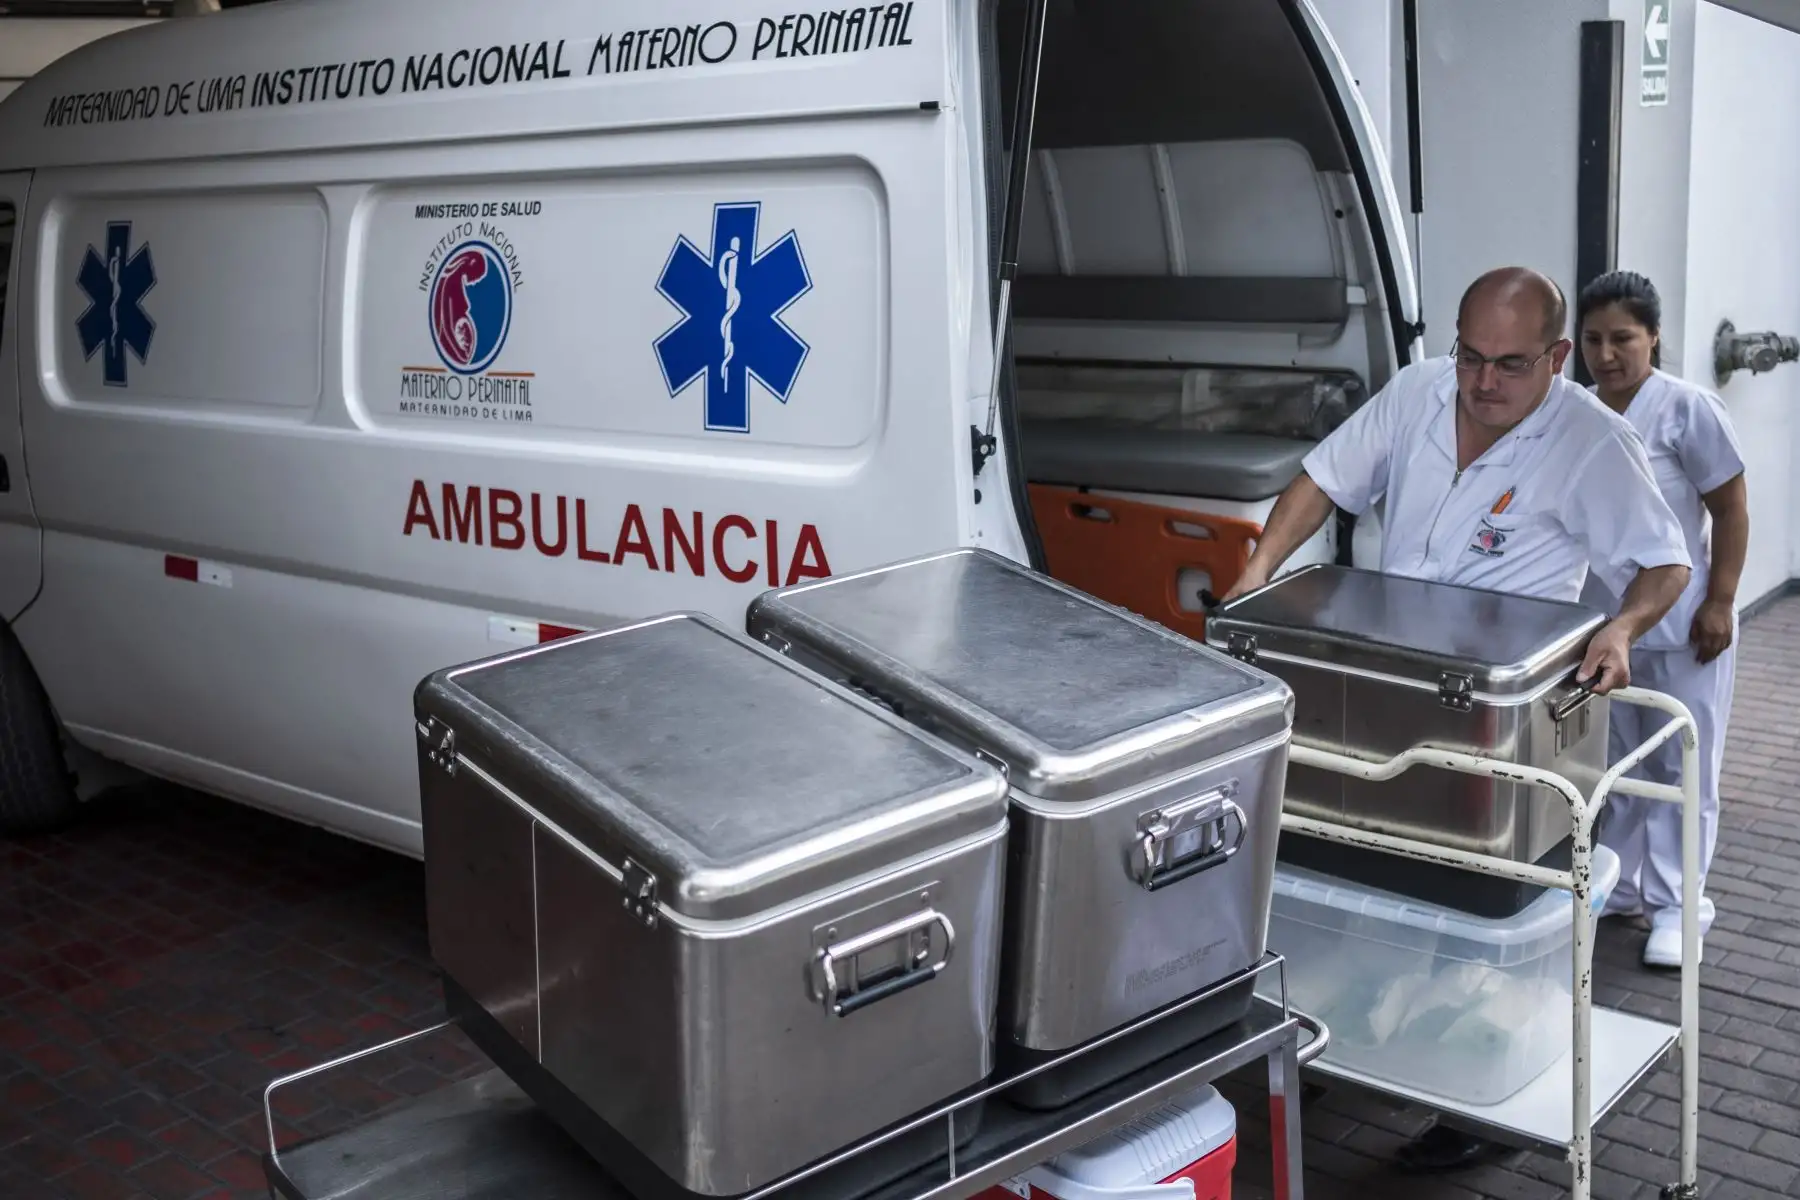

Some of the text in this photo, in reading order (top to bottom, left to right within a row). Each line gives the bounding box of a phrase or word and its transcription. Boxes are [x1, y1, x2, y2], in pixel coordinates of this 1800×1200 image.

[44, 2, 914, 128] MATERNIDAD DE LIMA INSTITUTO NACIONAL MATERNO PERINATAL
[415, 201, 542, 219] MINISTERIO DE SALUD
[418, 221, 524, 293] INSTITUTO NACIONAL
[399, 402, 533, 422] MATERNIDAD DE LIMA
[400, 373, 532, 406] MATERNO PERINATAL
[402, 479, 832, 587] AMBULANCIA
